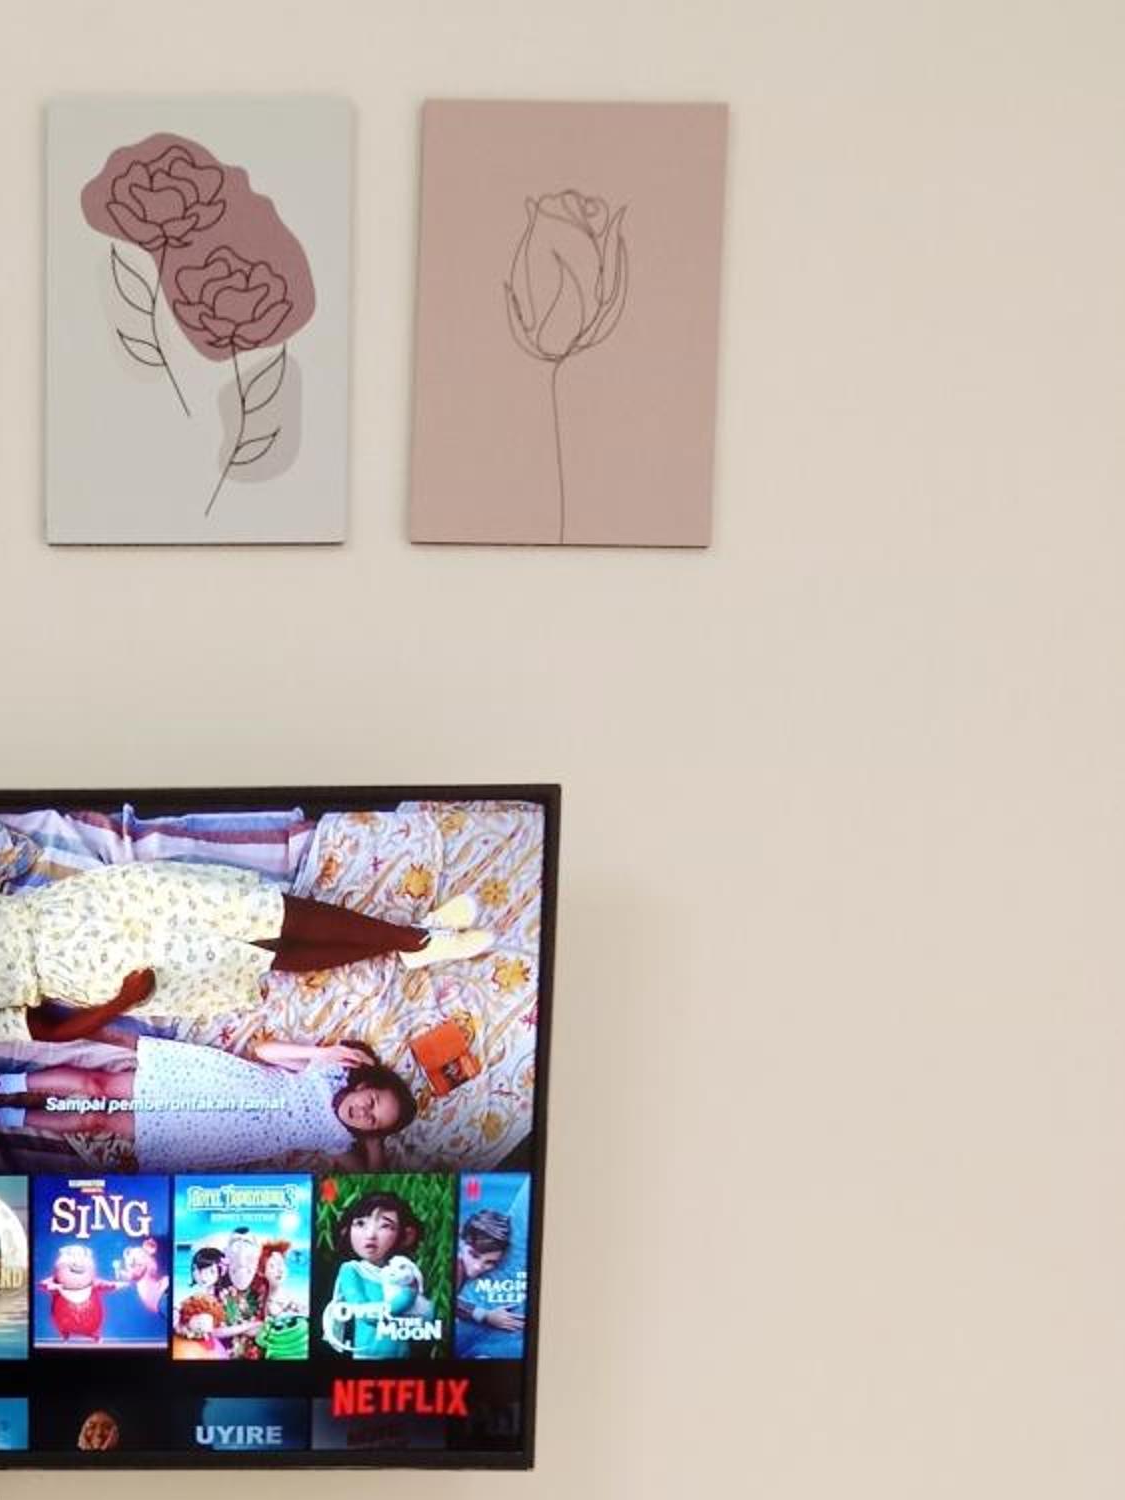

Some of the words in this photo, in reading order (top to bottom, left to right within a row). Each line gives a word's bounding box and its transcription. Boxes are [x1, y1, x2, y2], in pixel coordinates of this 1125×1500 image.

[45, 1097, 107, 1114] Sampai
[50, 1195, 153, 1239] SING
[334, 1302, 393, 1323] OVER
[397, 1317, 424, 1327] THE
[376, 1319, 443, 1342] MOON
[332, 1379, 470, 1417] NETFLIX
[196, 1425, 283, 1445] UYIRE
